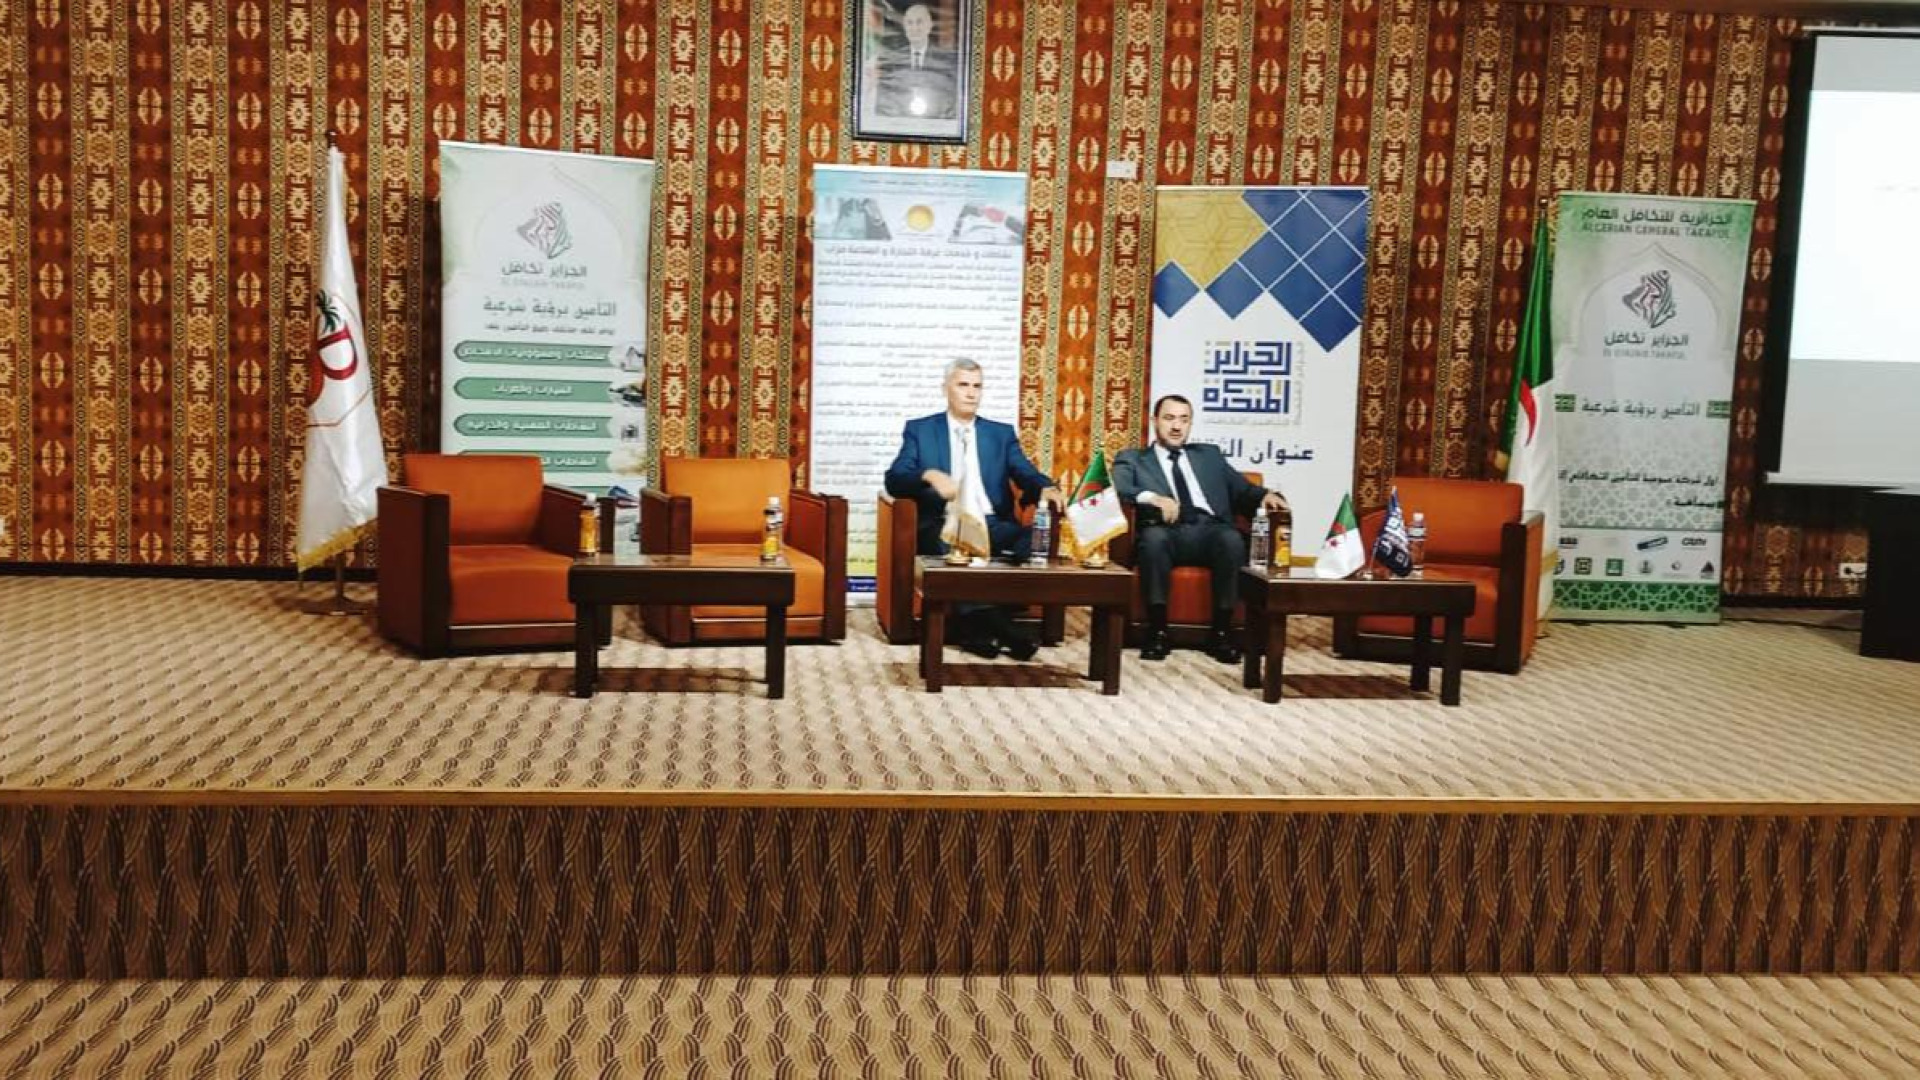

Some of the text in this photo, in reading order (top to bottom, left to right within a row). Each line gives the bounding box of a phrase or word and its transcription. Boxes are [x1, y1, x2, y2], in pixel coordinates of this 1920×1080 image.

[1581, 206, 1619, 220] العام
[1624, 207, 1675, 223] للتكافل
[1248, 438, 1314, 465] عنوان
